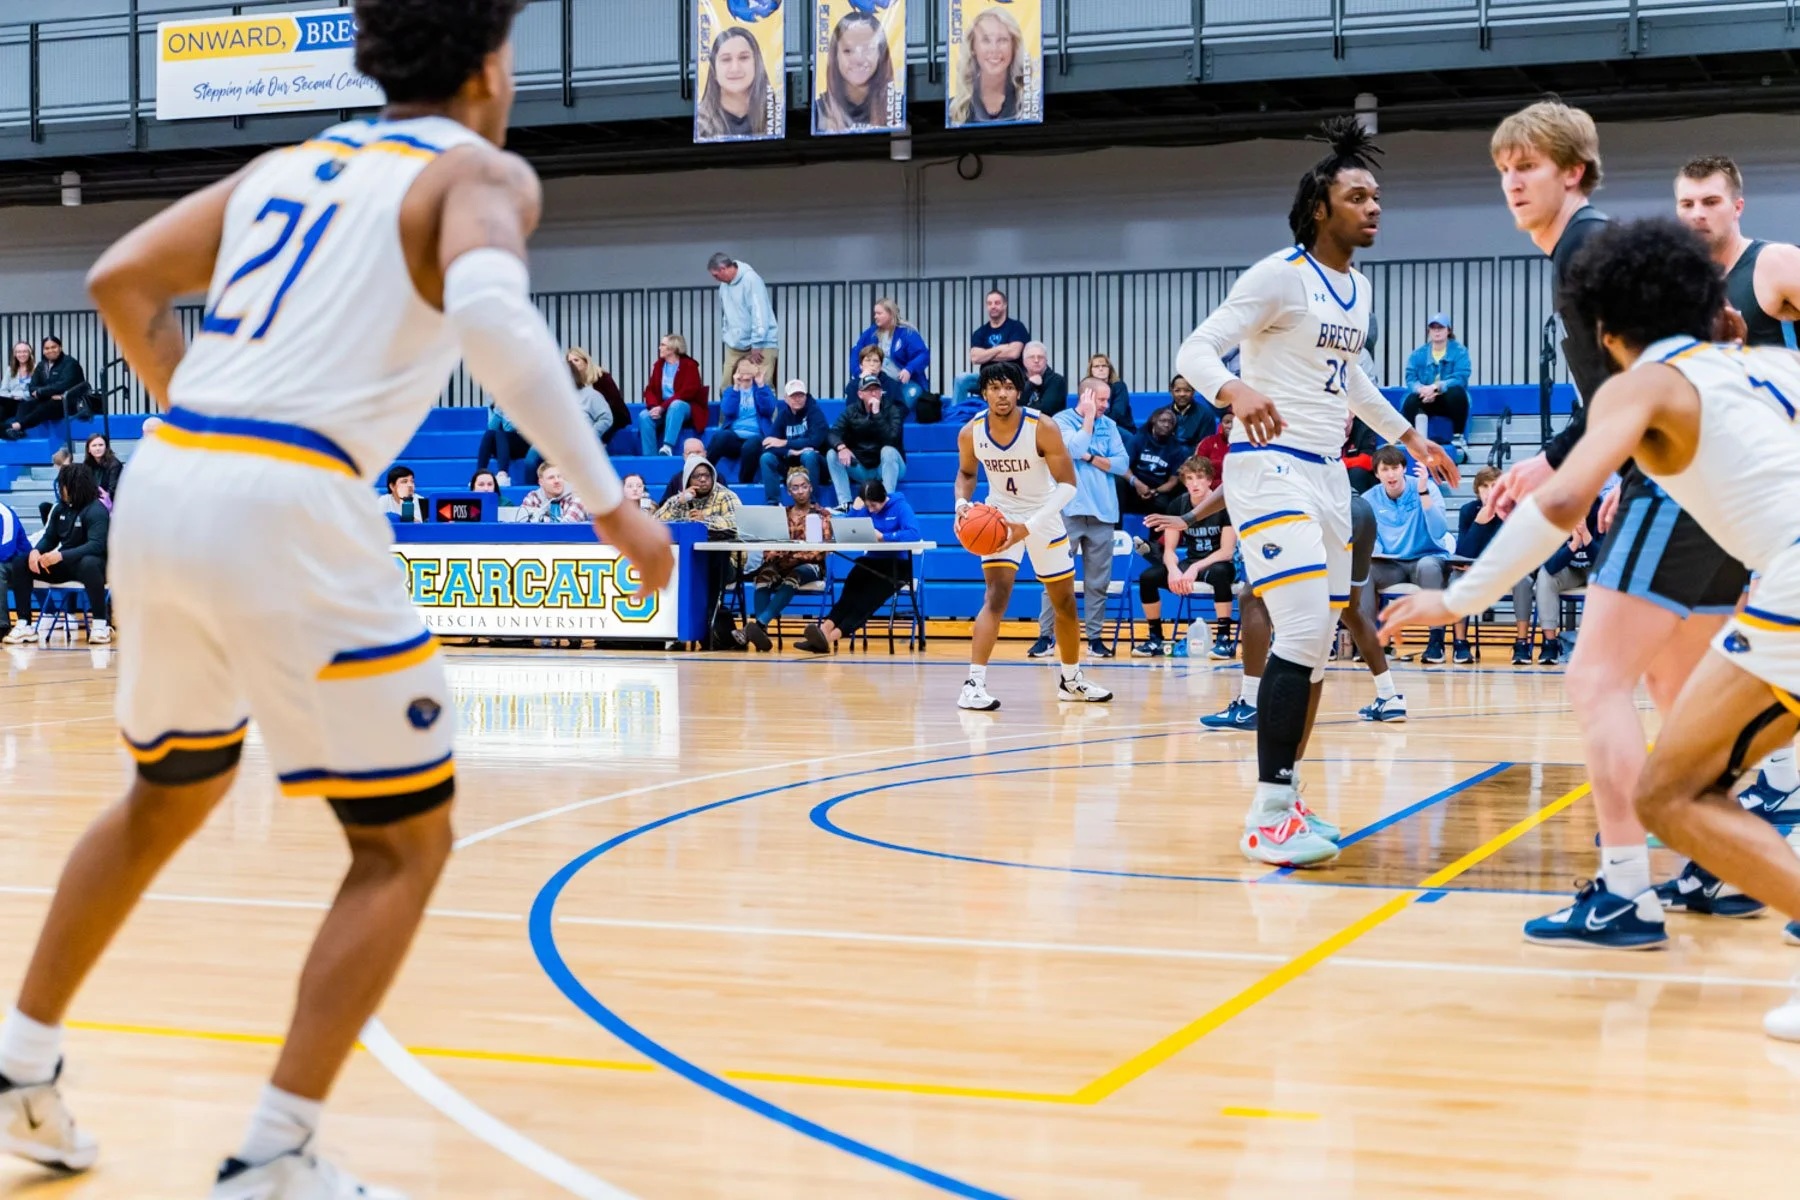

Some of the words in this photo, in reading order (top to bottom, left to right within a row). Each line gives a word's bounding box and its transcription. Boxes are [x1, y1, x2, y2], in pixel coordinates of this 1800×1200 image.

[168, 26, 286, 53] ONWARD,
[193, 82, 242, 101] Stepping
[246, 78, 265, 97] into
[267, 76, 290, 97] Our
[292, 73, 336, 93] Second
[200, 197, 342, 342] 21
[1316, 323, 1366, 354] BRESCIA
[984, 459, 1031, 472] BRESCIA
[1006, 477, 1018, 495] 4
[453, 504, 467, 519] POSS
[425, 615, 487, 628] RESCIA
[496, 615, 608, 629] UNIVERSITY
